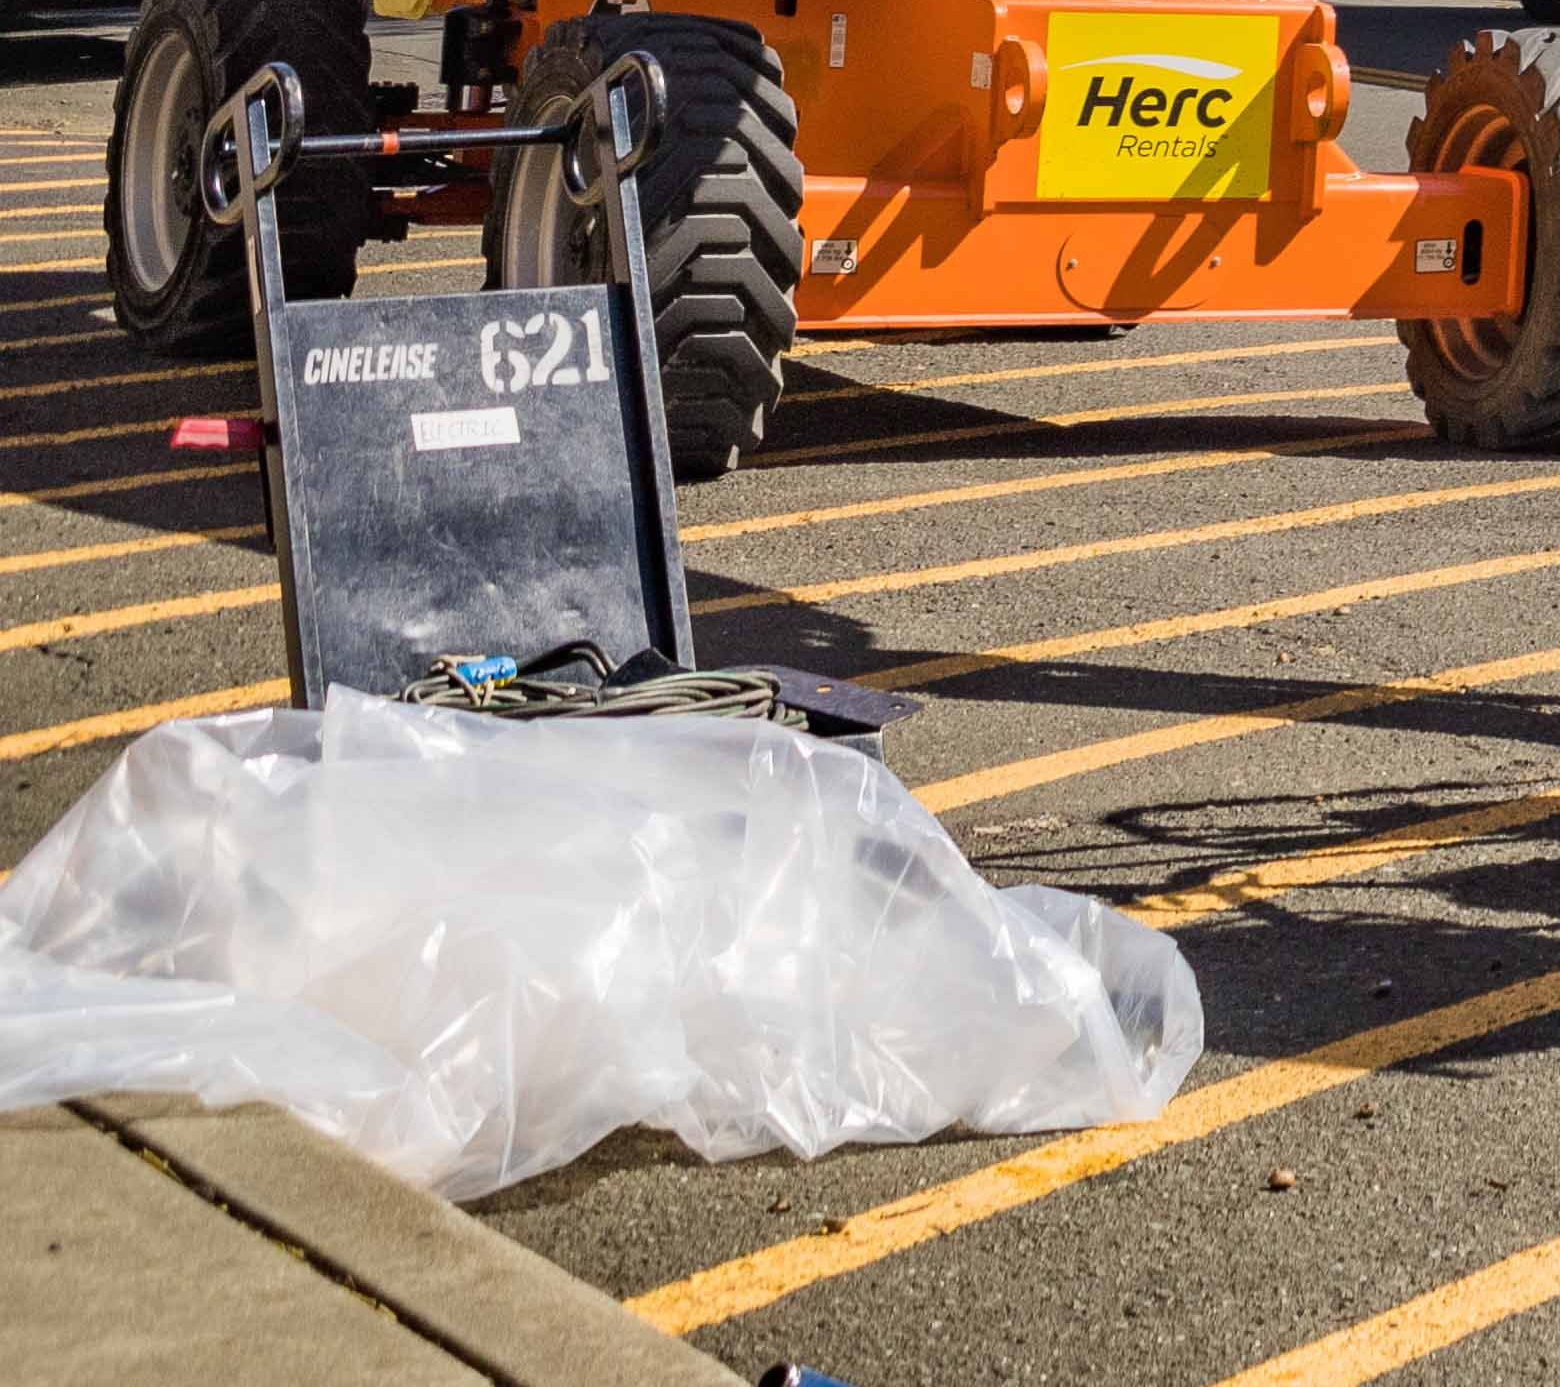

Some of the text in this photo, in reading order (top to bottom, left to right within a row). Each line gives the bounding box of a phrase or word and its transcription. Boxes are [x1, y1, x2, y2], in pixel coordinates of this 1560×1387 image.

[1076, 77, 1233, 128] Herc
[1115, 134, 1219, 158] Rentals
[304, 306, 611, 395] CINELEASE 621
